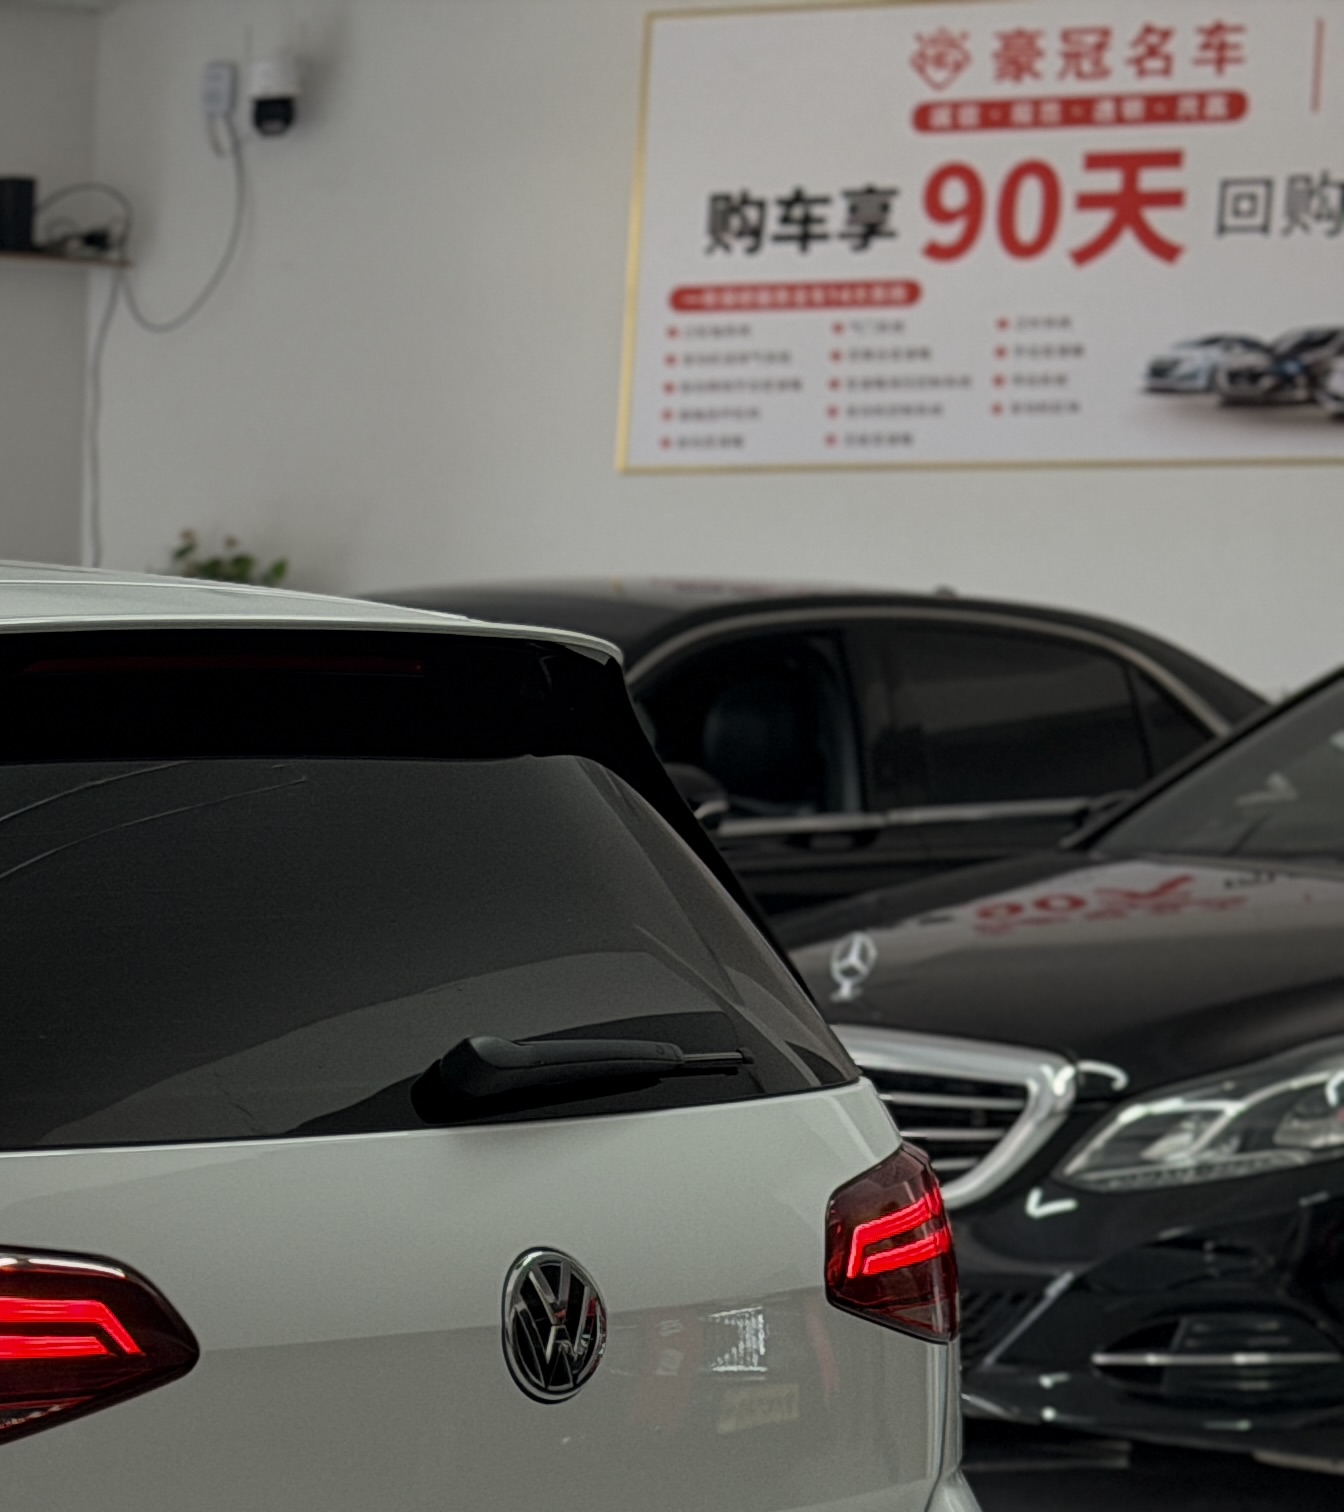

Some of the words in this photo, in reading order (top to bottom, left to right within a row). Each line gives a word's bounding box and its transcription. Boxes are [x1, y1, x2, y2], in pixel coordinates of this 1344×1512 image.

[991, 19, 1248, 83] 豪冠名车
[705, 182, 901, 255] 购车享
[920, 149, 1187, 268] 90天
